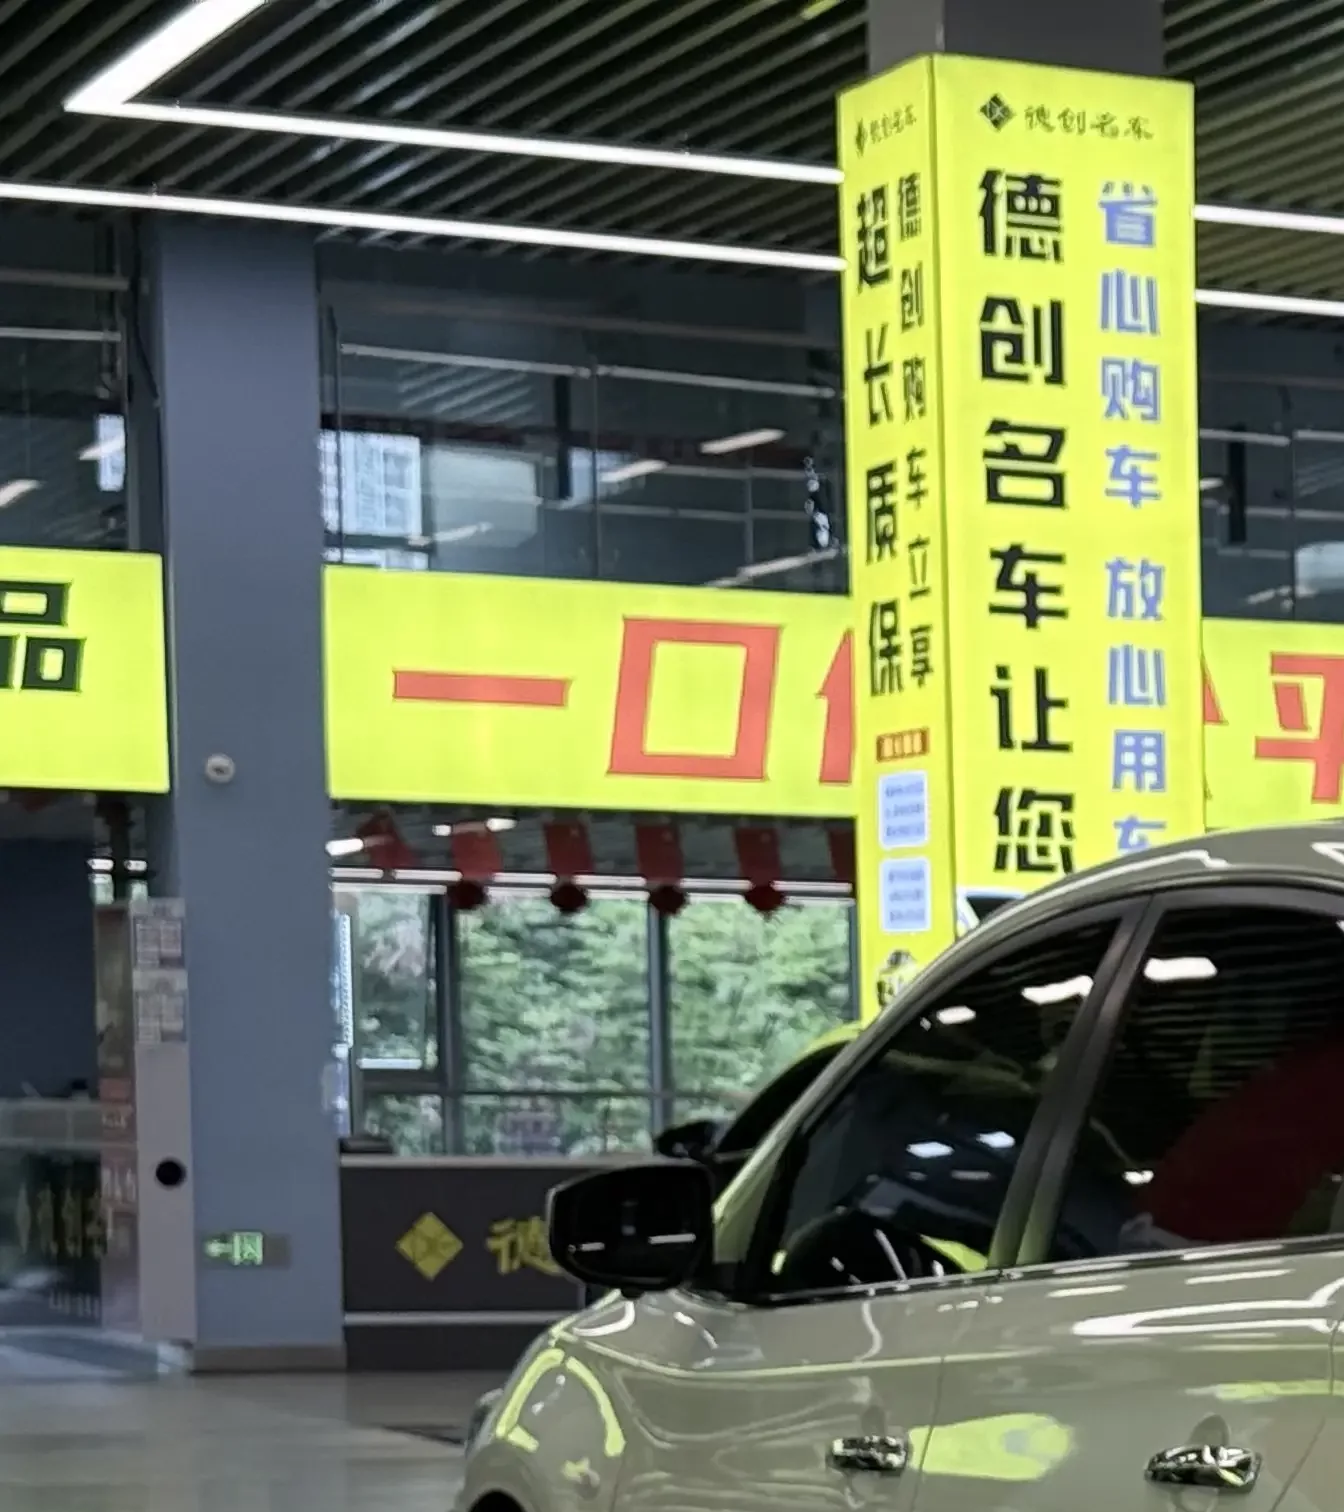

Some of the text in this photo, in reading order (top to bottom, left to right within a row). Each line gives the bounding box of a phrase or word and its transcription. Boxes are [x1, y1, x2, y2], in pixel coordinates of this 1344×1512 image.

[857, 184, 903, 697] 超长质保
[898, 172, 933, 687] 德创购车立享
[979, 168, 1075, 873] 德创名车让您
